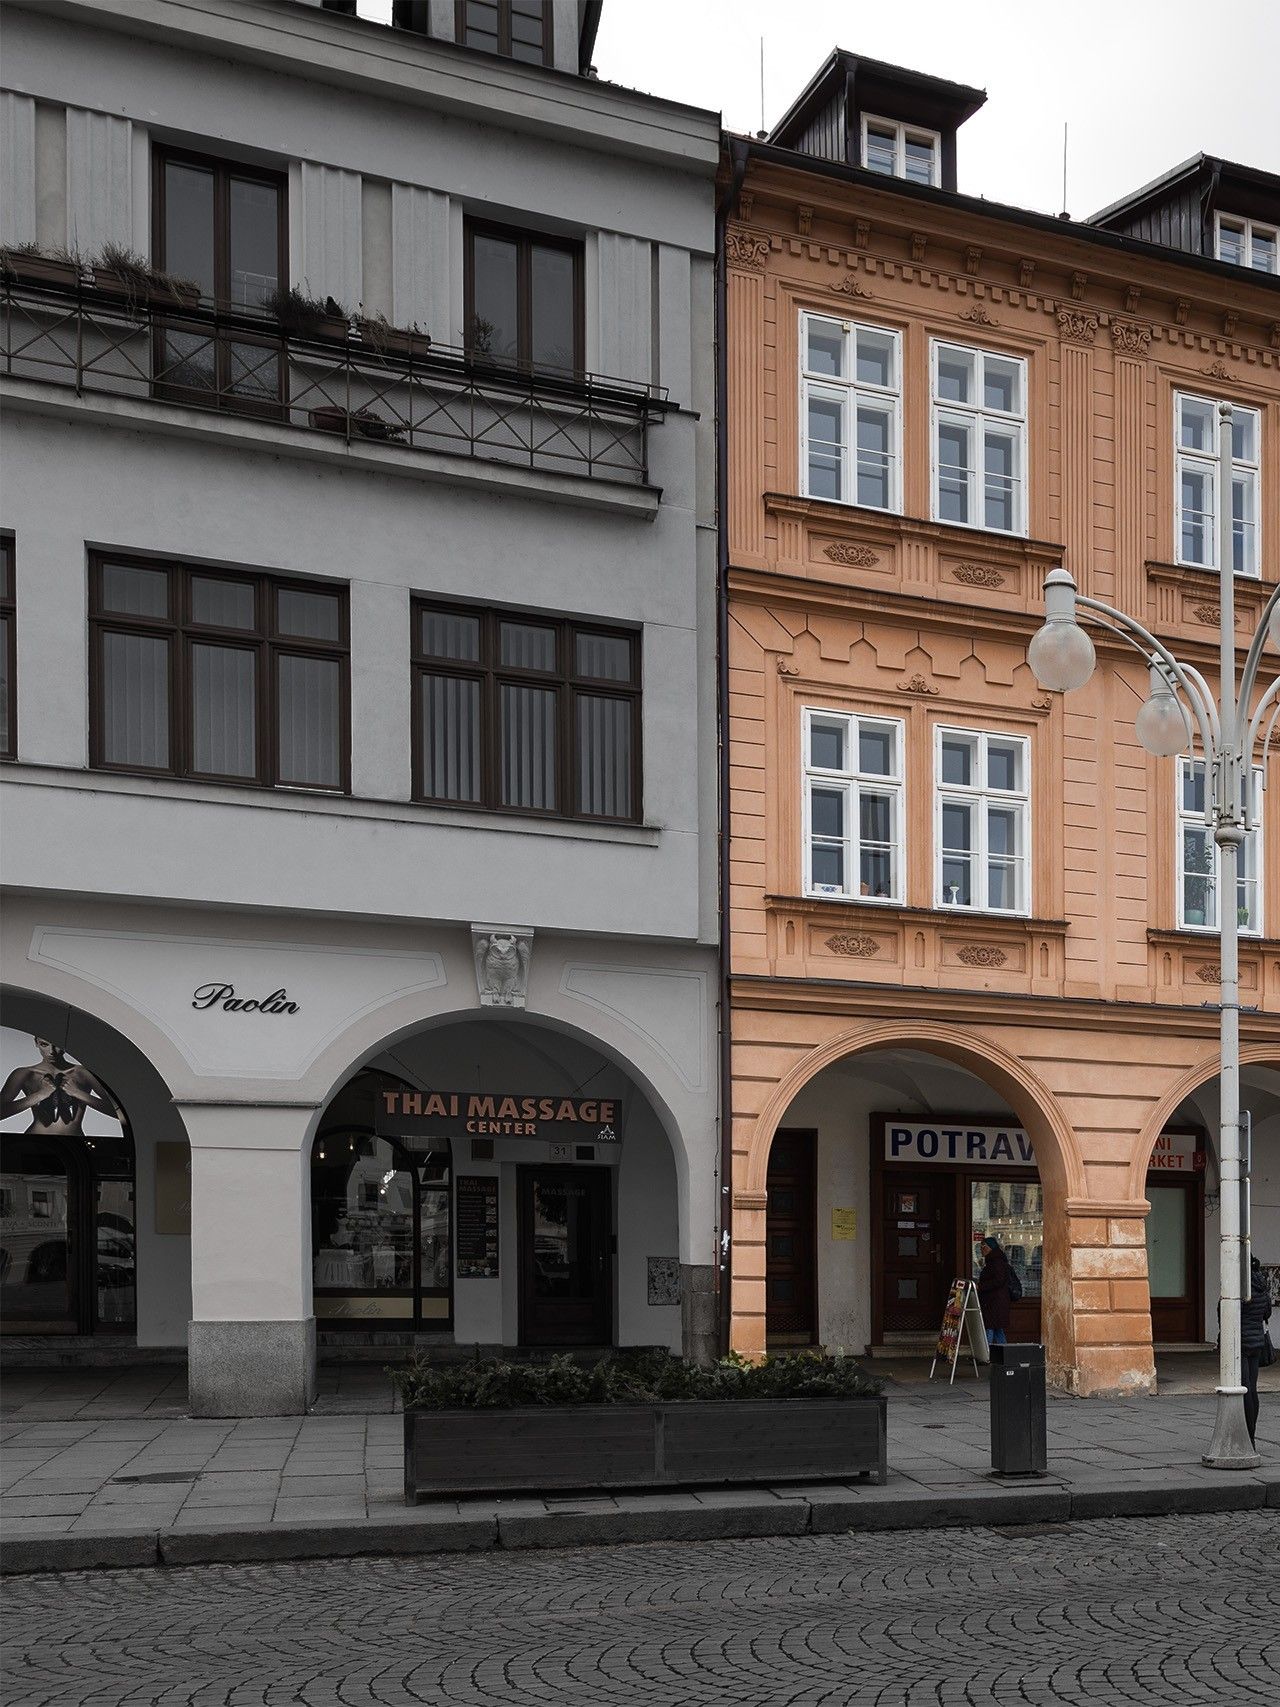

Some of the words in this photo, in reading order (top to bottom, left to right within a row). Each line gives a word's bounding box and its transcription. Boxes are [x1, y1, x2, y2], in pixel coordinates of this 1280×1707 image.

[192, 983, 300, 1014] Paolin
[382, 1092, 458, 1116] THAI
[467, 1096, 615, 1123] MASSAGE
[466, 1120, 537, 1135] CENTER
[554, 1146, 566, 1155] 31
[541, 1188, 587, 1196] MASSAGE
